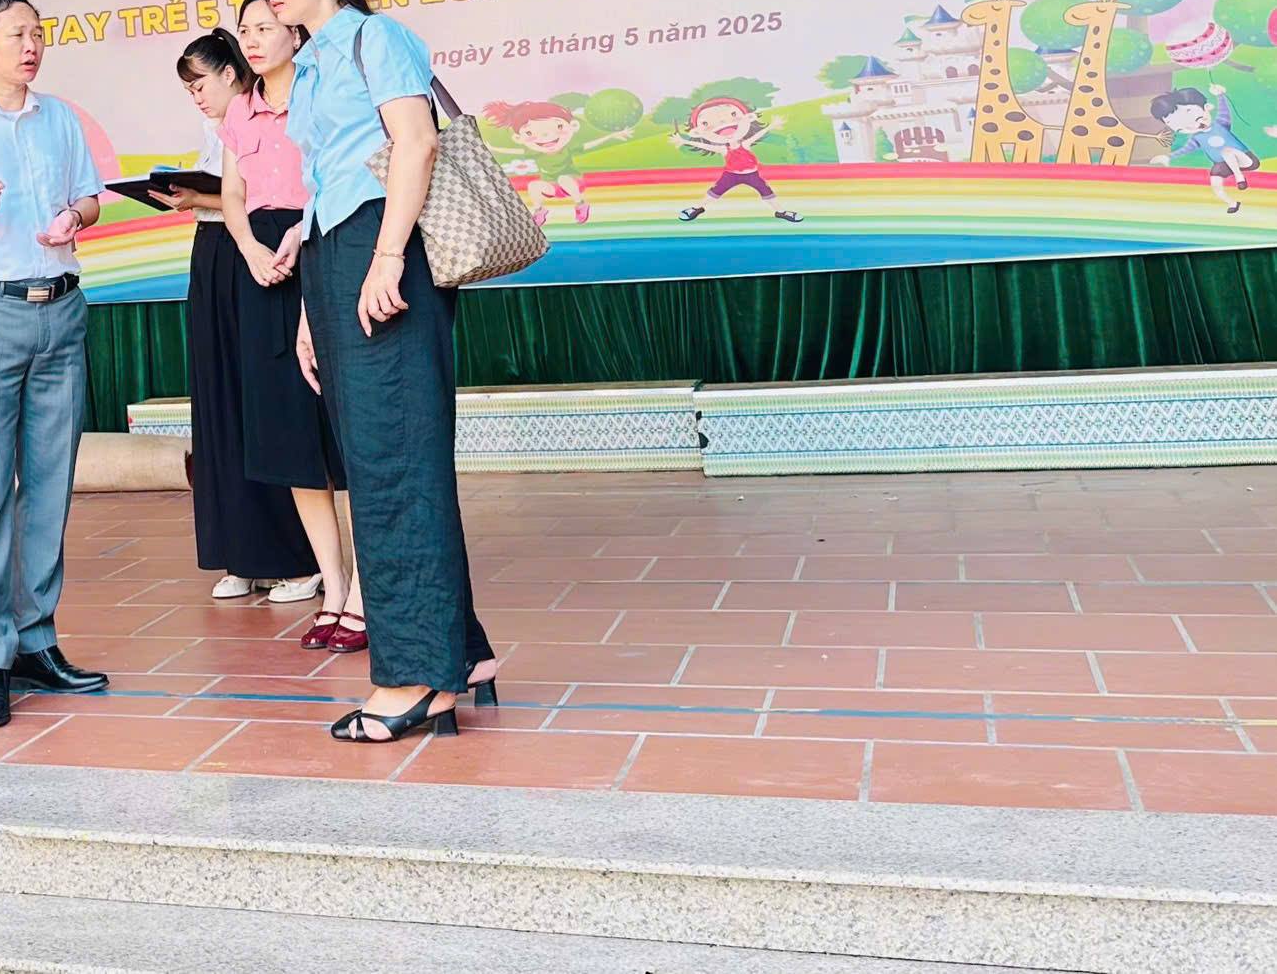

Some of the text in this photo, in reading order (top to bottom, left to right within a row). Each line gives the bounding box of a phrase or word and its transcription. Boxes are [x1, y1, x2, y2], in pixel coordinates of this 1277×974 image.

[41, 10, 112, 47] TAY
[196, 0, 221, 28] 5
[432, 11, 784, 68] ngày 28 tháng 5 năm 2025
